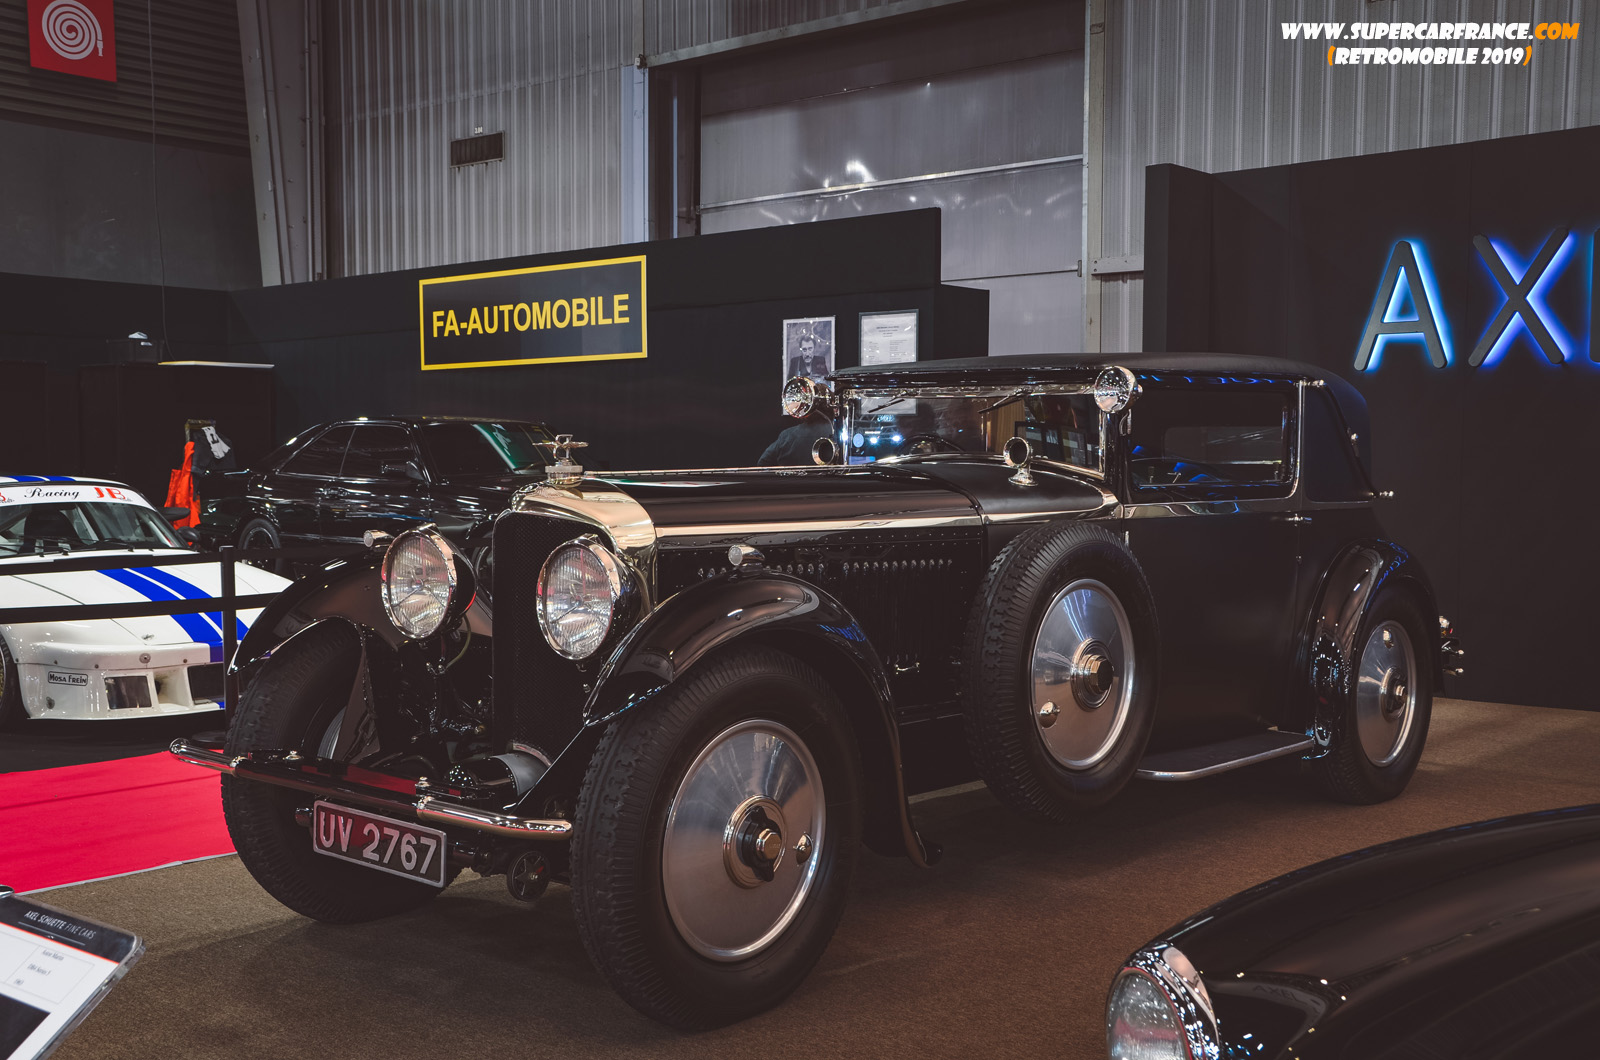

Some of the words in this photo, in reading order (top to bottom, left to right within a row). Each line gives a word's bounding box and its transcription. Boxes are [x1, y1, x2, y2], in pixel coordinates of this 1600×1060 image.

[432, 293, 630, 338] FA-AUTOMOBILE
[1353, 227, 1600, 371] AX
[24, 487, 80, 499] Racing
[320, 811, 353, 853] UV
[362, 823, 437, 874] 2767
[24, 911, 40, 920] AXEL
[38, 915, 67, 929] SCHUETTE
[65, 923, 81, 934] FINE
[79, 928, 96, 939] CARS
